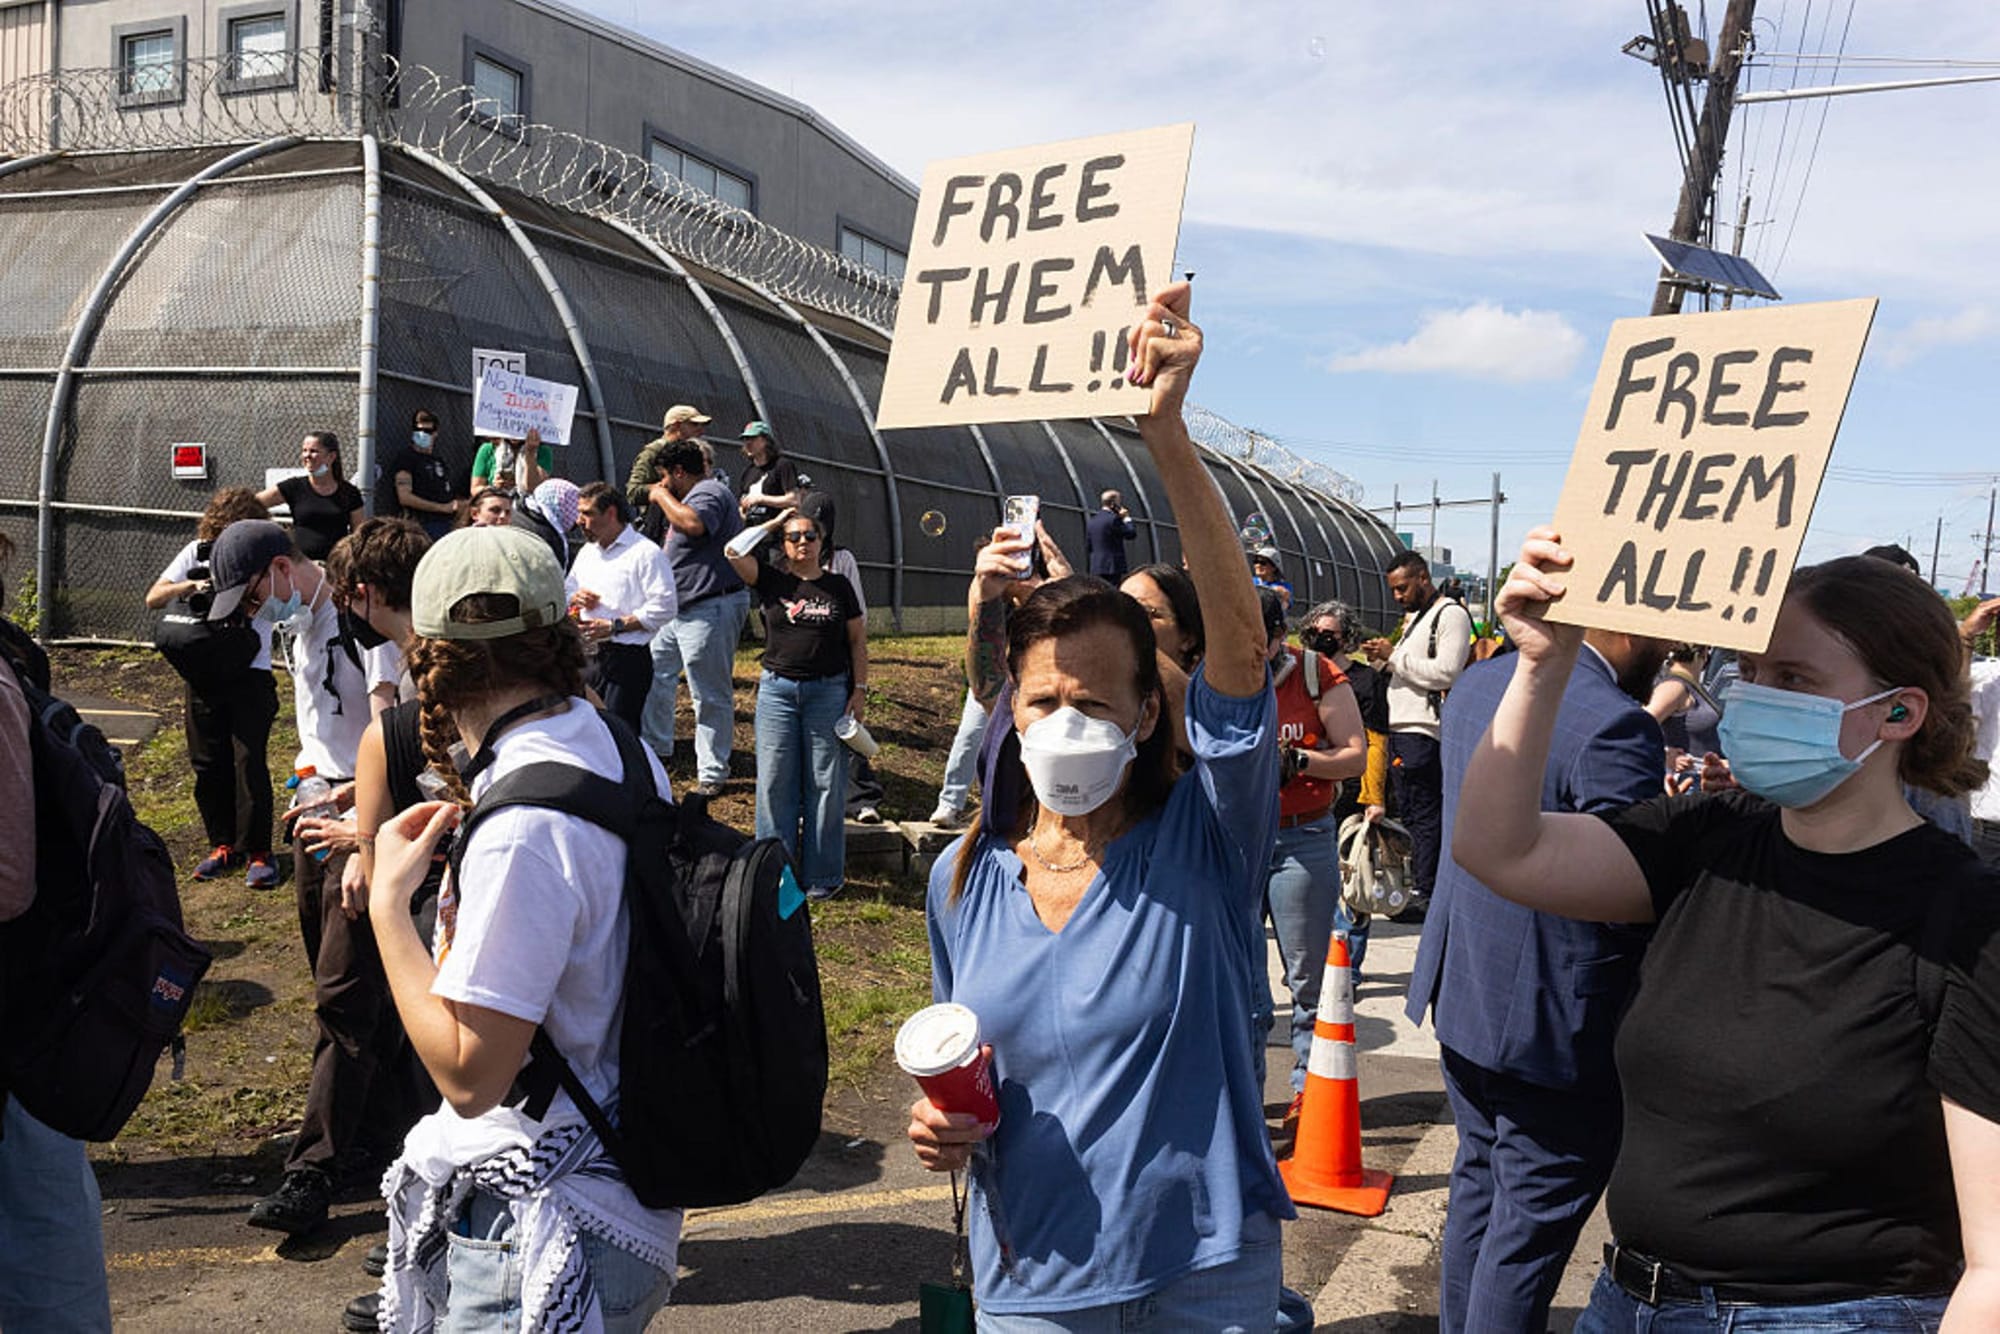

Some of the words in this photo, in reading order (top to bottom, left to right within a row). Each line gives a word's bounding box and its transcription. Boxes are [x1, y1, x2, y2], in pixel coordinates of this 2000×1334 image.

[932, 154, 1126, 246] FREE
[917, 244, 1148, 326] THEM
[939, 325, 1131, 405] ALL!!
[1604, 336, 1814, 440] FREE
[1604, 448, 1796, 533] THEM
[1596, 540, 1778, 624] ALL!!
[1277, 721, 1304, 741] OU
[1055, 783, 1079, 794] 3M
